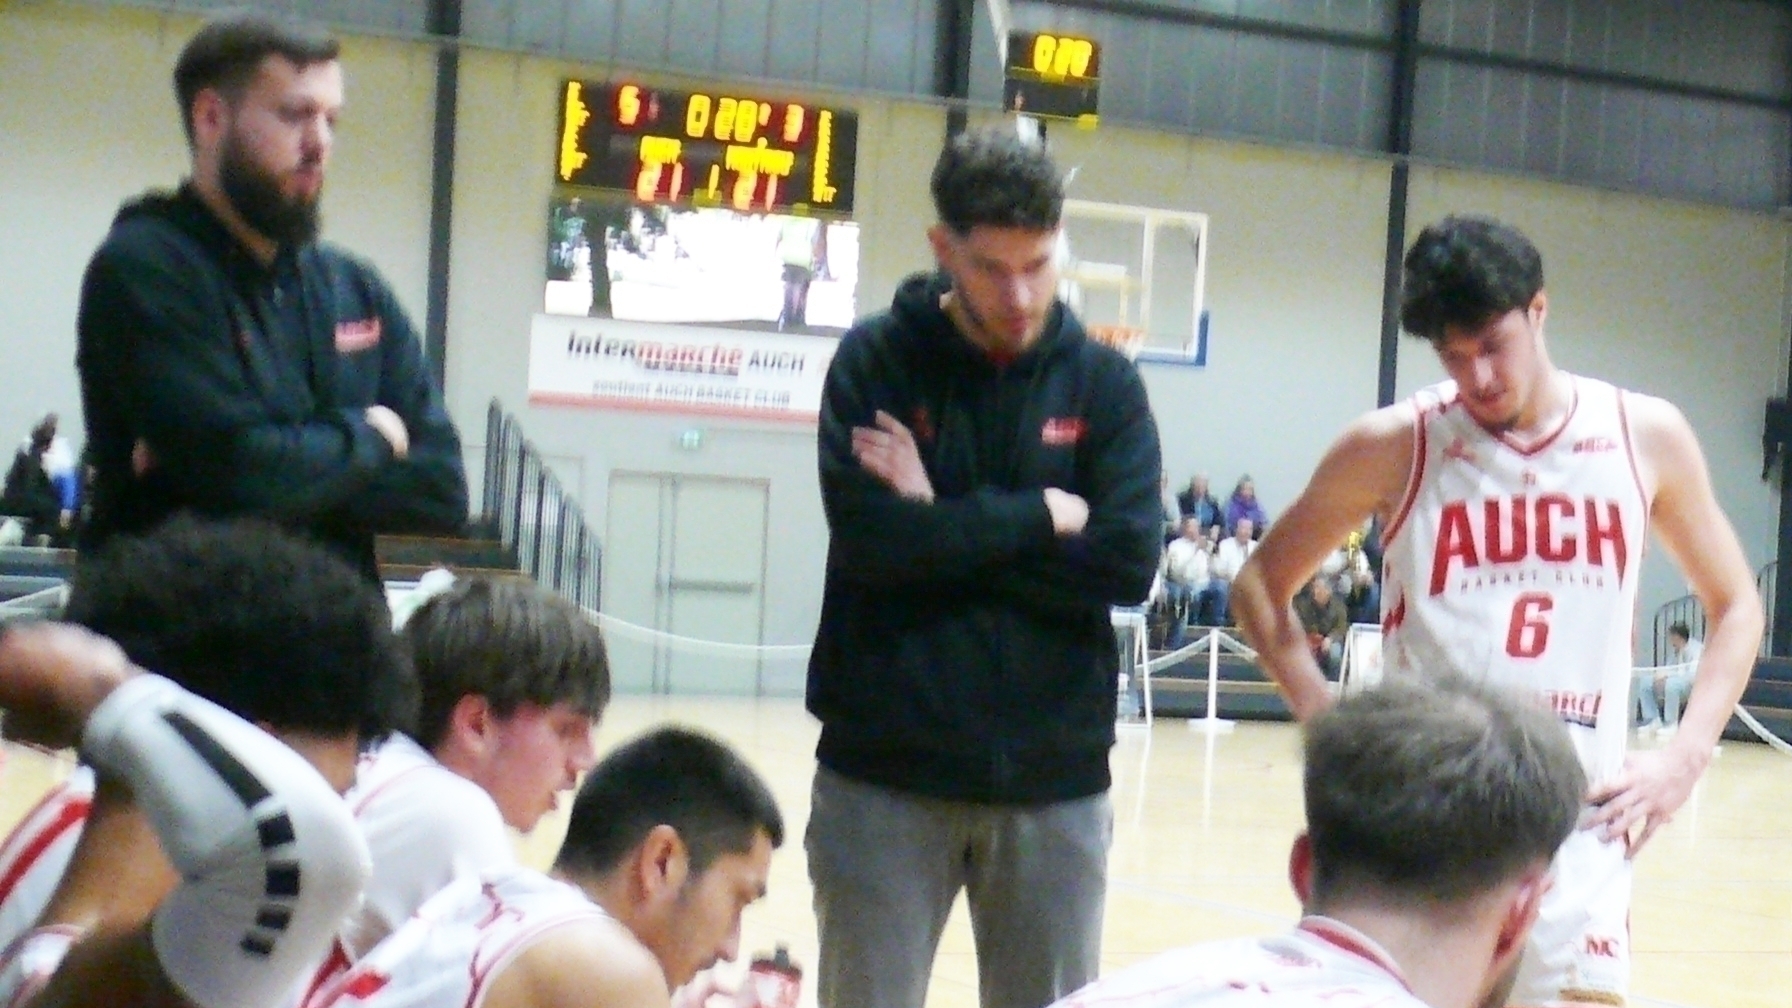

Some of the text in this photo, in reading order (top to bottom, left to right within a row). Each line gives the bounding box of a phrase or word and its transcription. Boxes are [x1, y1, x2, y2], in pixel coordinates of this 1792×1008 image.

[748, 349, 805, 373] AUCH
[1429, 493, 1627, 597] AUCH
[1506, 590, 1553, 658] 6
